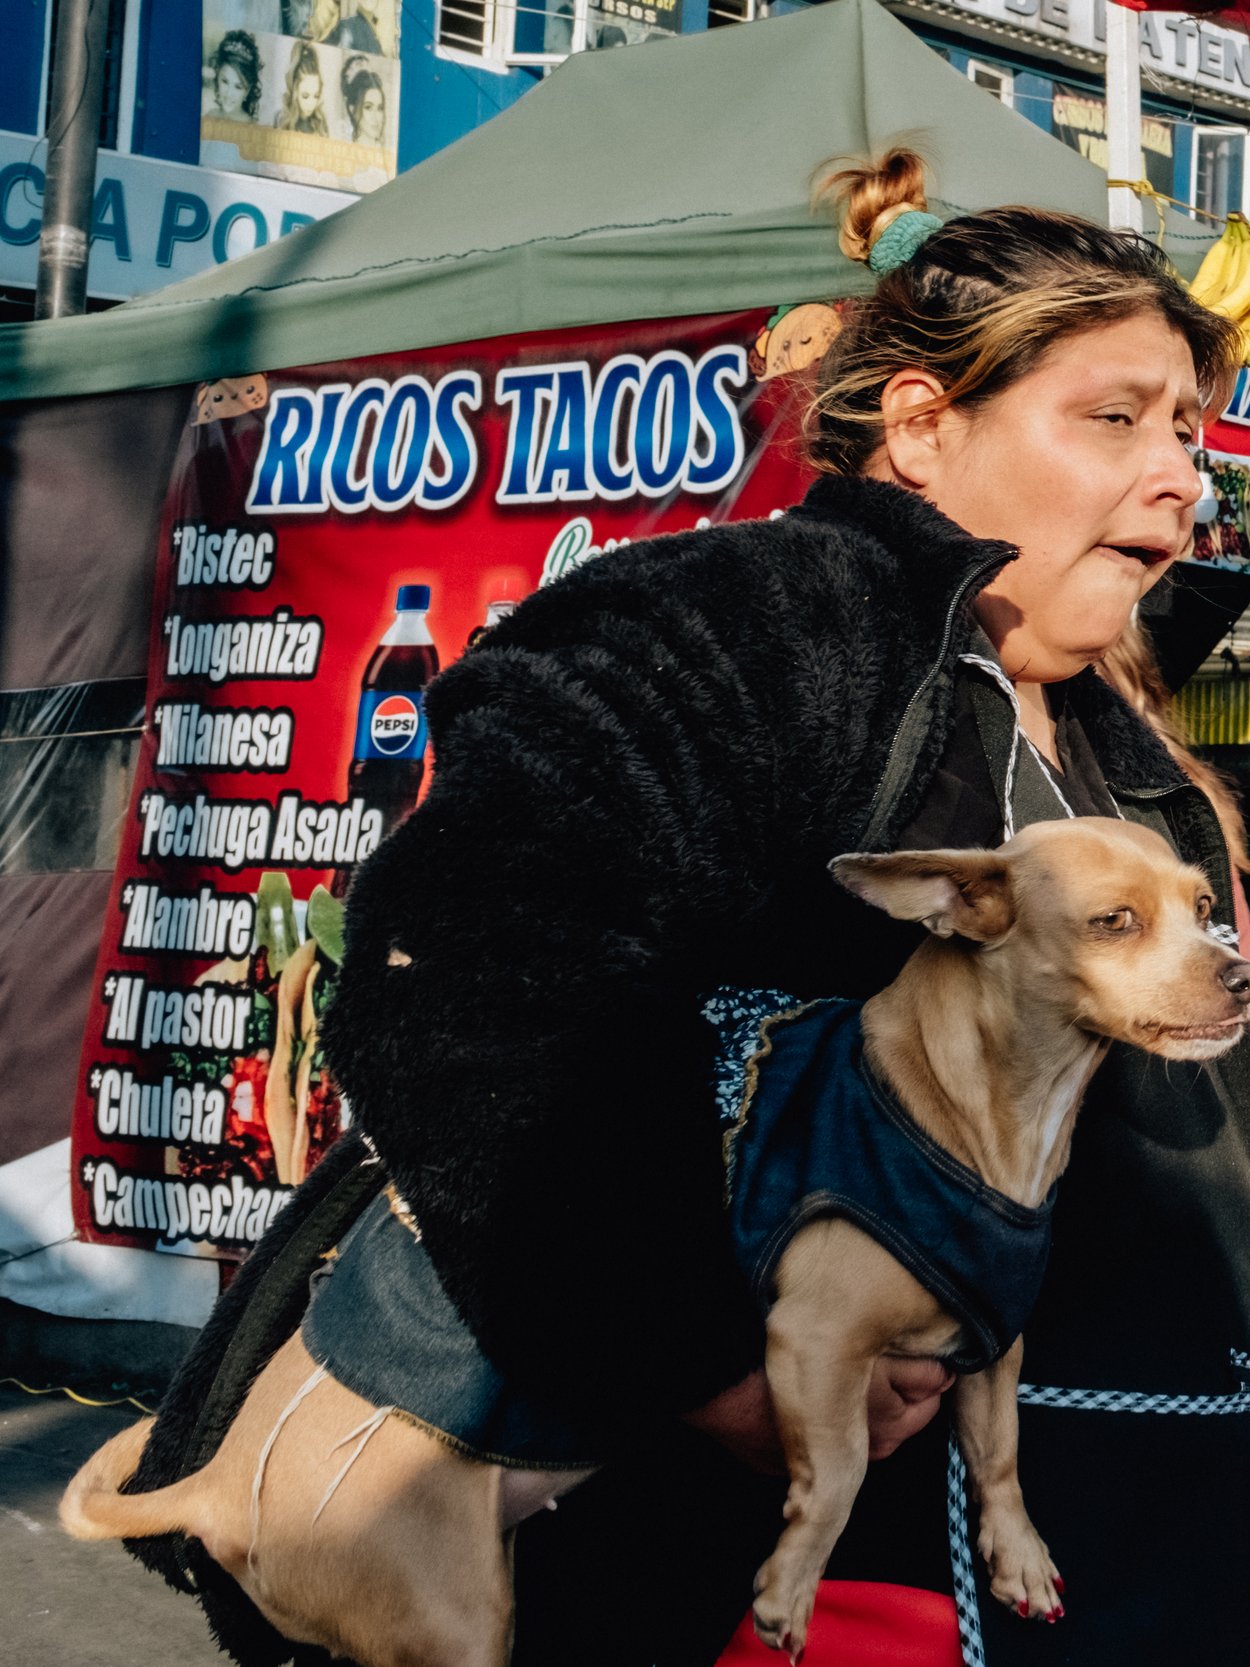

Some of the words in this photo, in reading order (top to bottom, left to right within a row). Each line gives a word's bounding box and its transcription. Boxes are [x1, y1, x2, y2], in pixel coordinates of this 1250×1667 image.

[245, 370, 482, 514] RICOS
[495, 345, 747, 504] TACOS
[375, 719, 415, 731] PEPSI
[271, 796, 383, 862] Asada
[142, 988, 251, 1050] pastor
